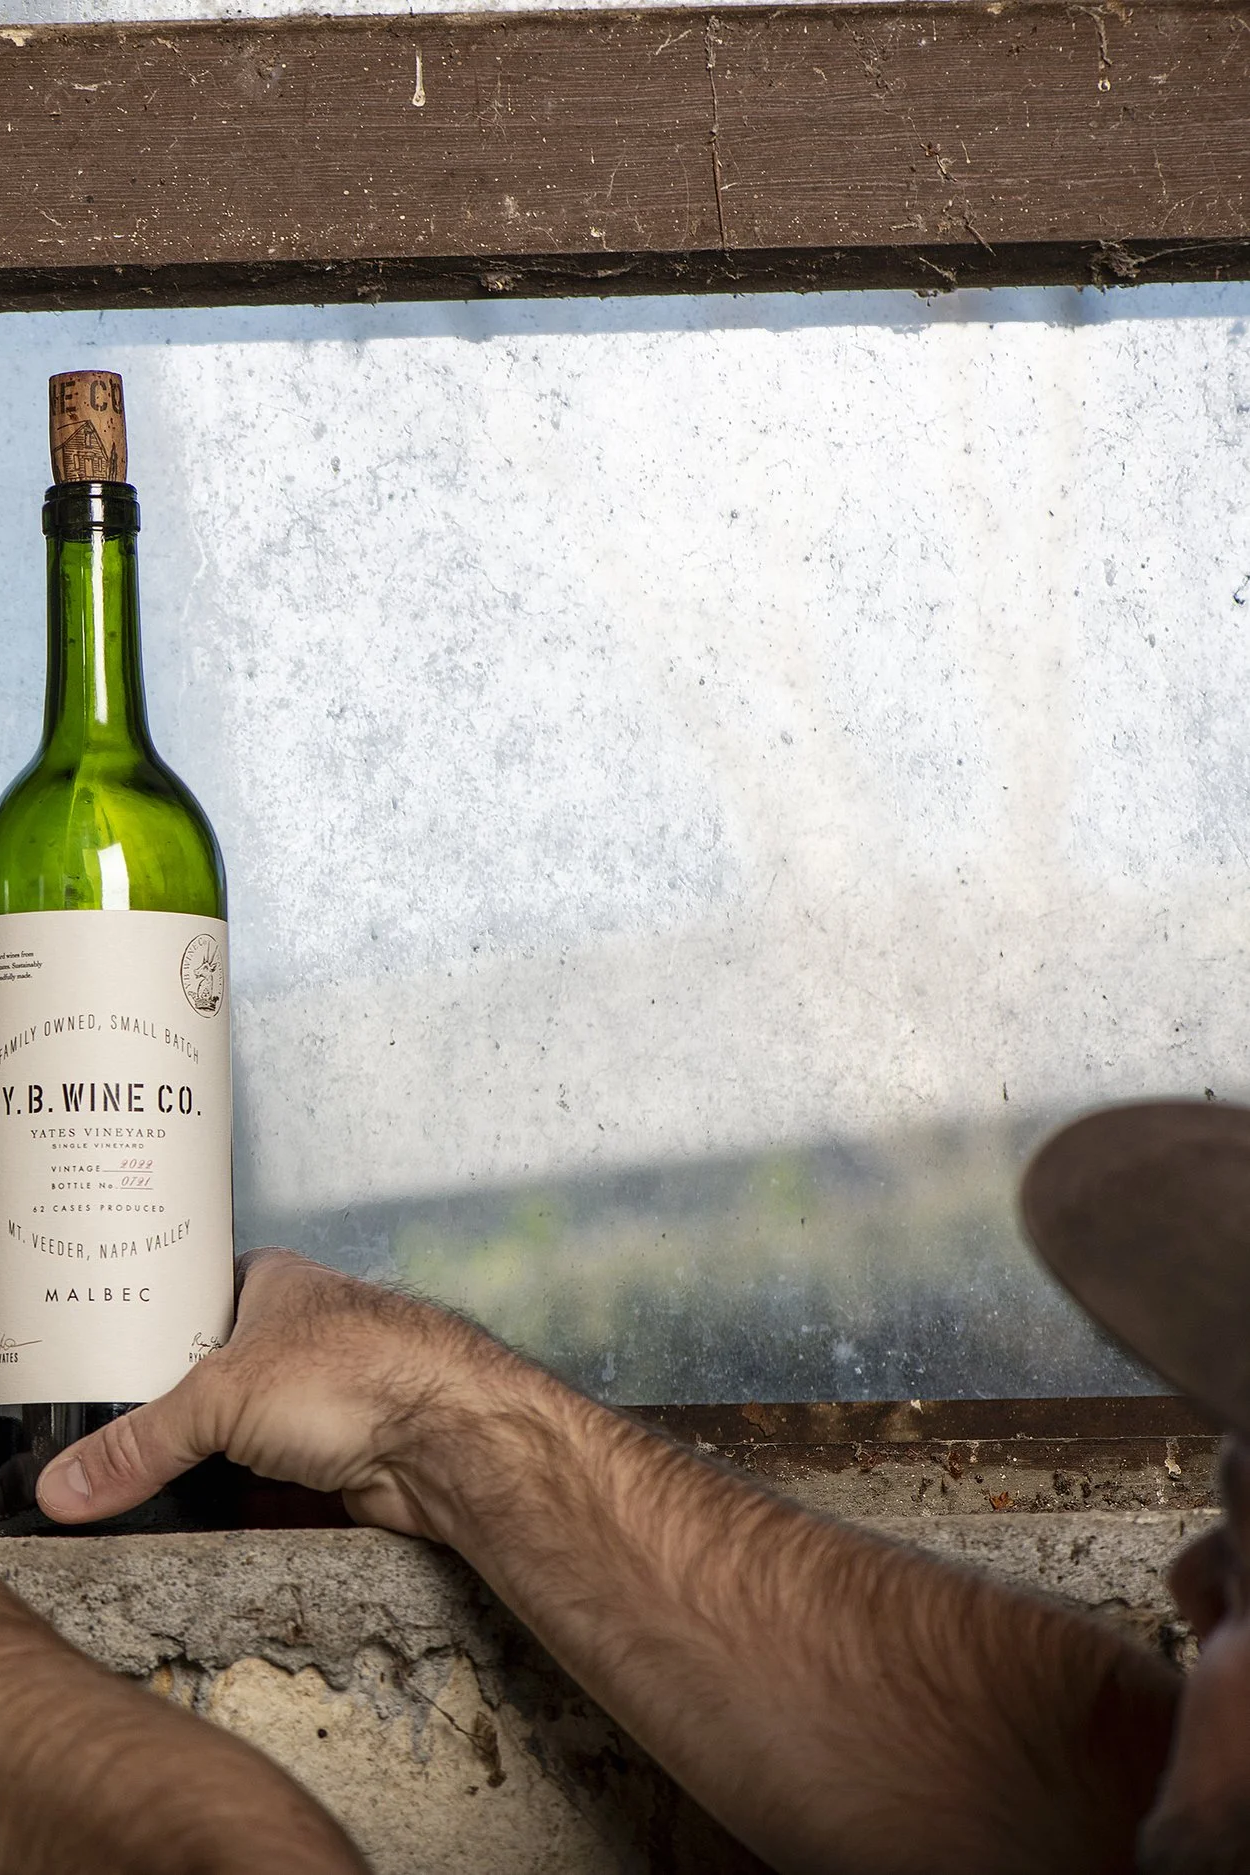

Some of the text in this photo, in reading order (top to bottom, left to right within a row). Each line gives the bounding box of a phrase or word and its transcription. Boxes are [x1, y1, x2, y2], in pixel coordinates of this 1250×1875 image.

[0, 1014, 199, 1064] FAMILY OWNED, SMALL BATCH
[2, 1083, 201, 1116] Y.B. WINE CO.
[30, 1127, 167, 1139] YATES VINEYARD
[120, 1158, 153, 1169] 2022
[51, 1182, 91, 1190] BOTTLE
[32, 1204, 165, 1213] 62 CASES PRODUCED
[8, 1219, 191, 1261] MT. VEEDER, NAPA VALLEY
[45, 1287, 151, 1303] MALBEC
